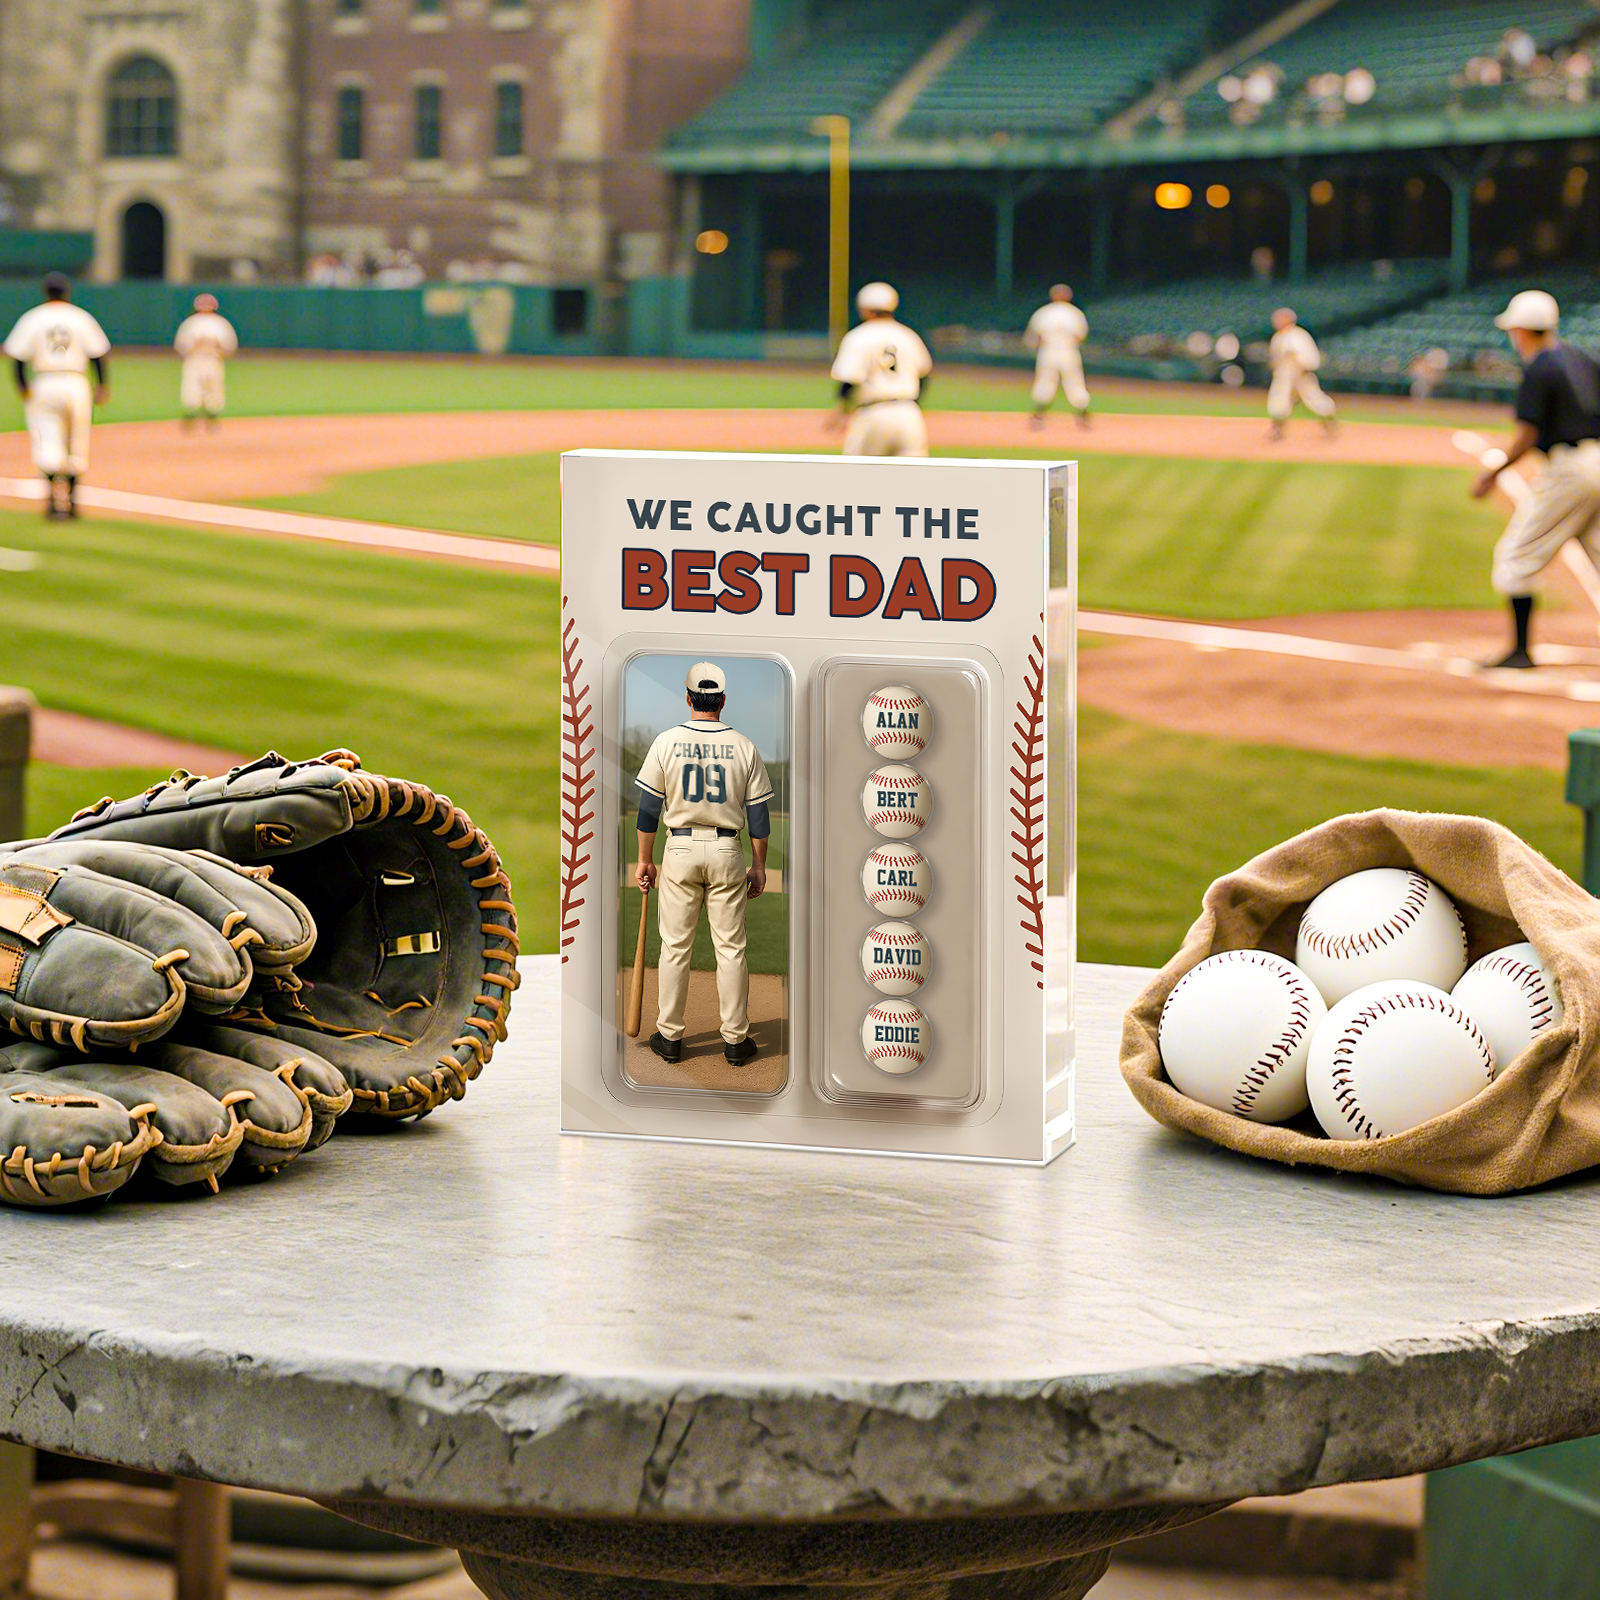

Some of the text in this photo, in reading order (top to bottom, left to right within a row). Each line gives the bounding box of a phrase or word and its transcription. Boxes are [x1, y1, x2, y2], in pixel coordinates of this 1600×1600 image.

[626, 498, 980, 540] WE CAUGHT THE
[621, 547, 997, 622] BEST DAD
[876, 711, 919, 729] ALAN
[673, 742, 734, 760] CHARLIE
[683, 763, 726, 803] 09
[877, 790, 918, 808] BERT
[877, 869, 917, 887] CARL
[873, 947, 921, 965] DAVID
[875, 1025, 920, 1043] EDDIE
